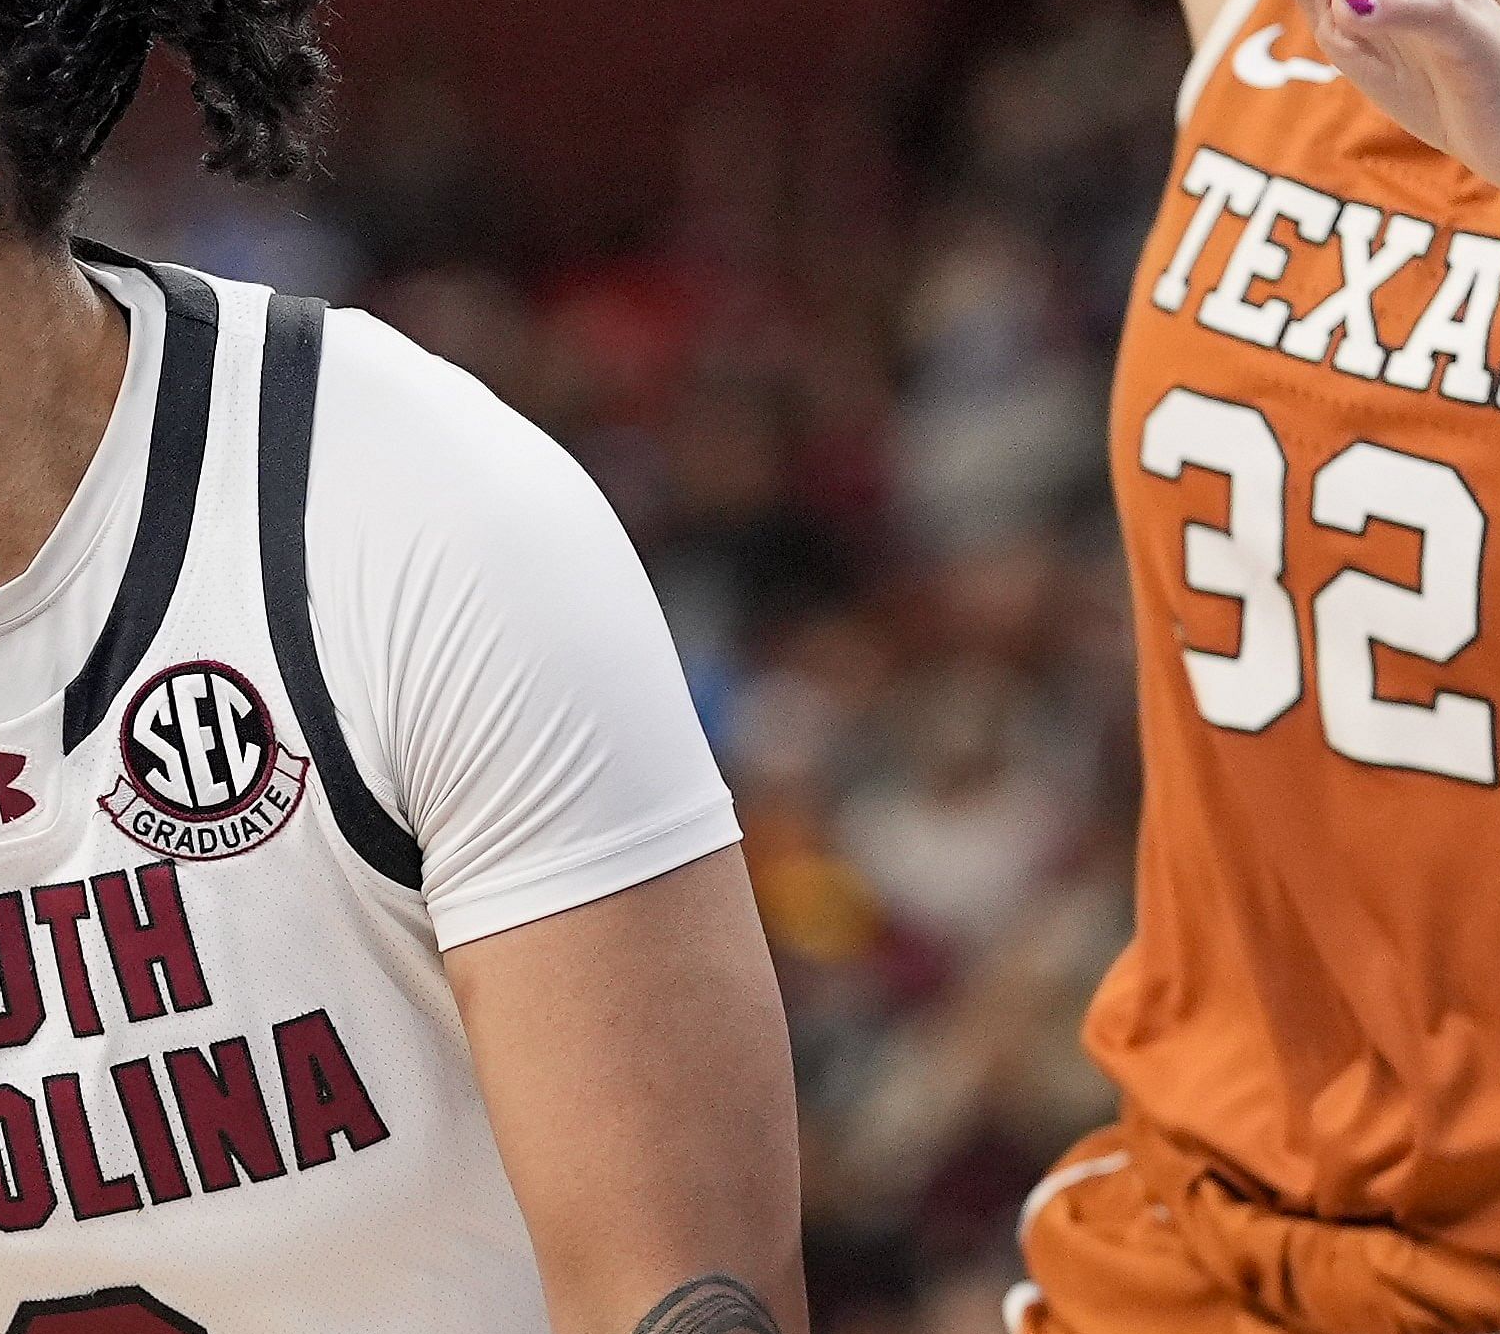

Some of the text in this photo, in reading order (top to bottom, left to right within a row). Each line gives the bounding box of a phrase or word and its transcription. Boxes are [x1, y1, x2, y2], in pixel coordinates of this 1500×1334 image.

[1138, 386, 1500, 788] 32
[132, 672, 262, 810] SEC
[131, 783, 293, 855] GRADUATE
